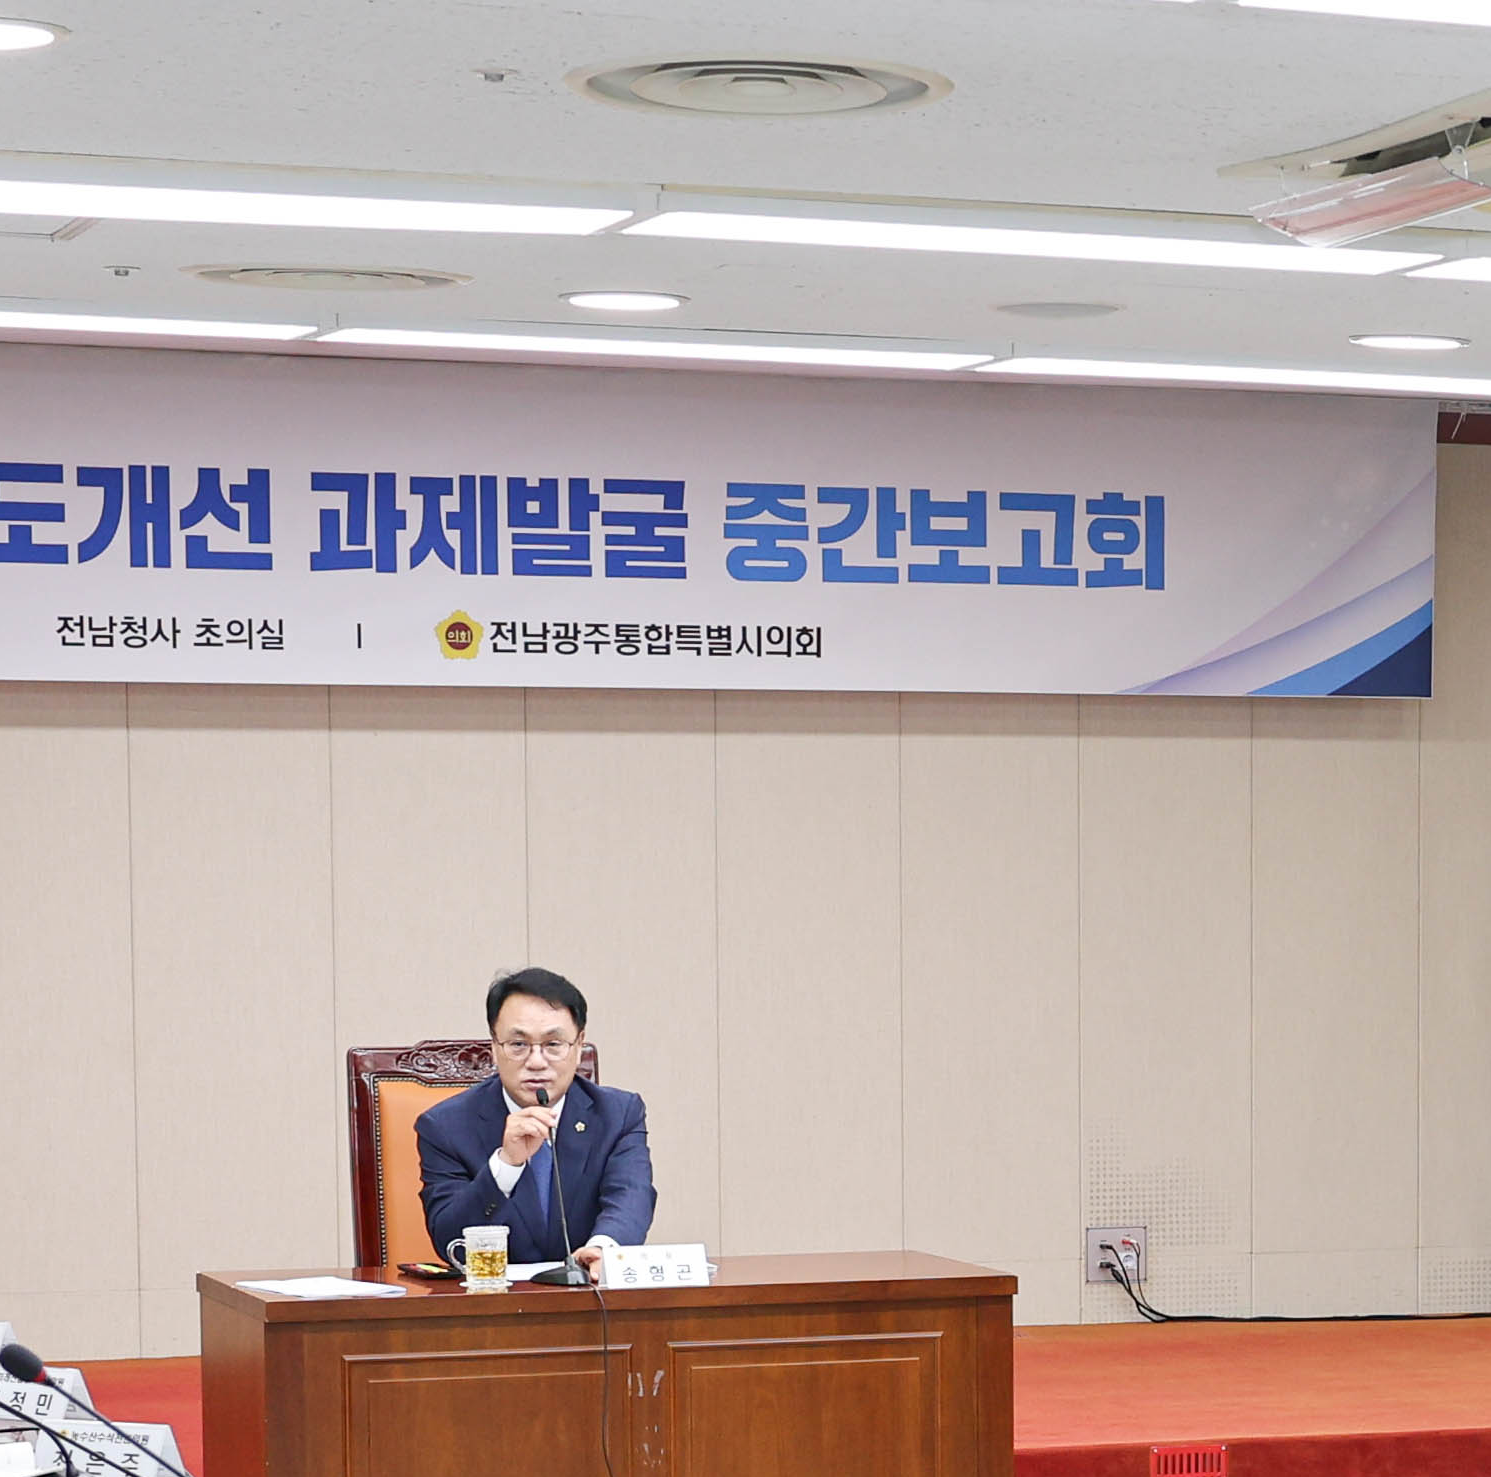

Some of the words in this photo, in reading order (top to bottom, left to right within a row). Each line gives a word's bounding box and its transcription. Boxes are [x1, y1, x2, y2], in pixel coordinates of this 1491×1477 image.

[310, 472, 688, 579] 과제발굴
[724, 483, 1164, 590] 중간보고회
[56, 615, 182, 650] 전남청사
[192, 617, 286, 652] 초의실
[447, 629, 471, 643] 의회
[489, 621, 822, 658] 전남광주통합특별시의회
